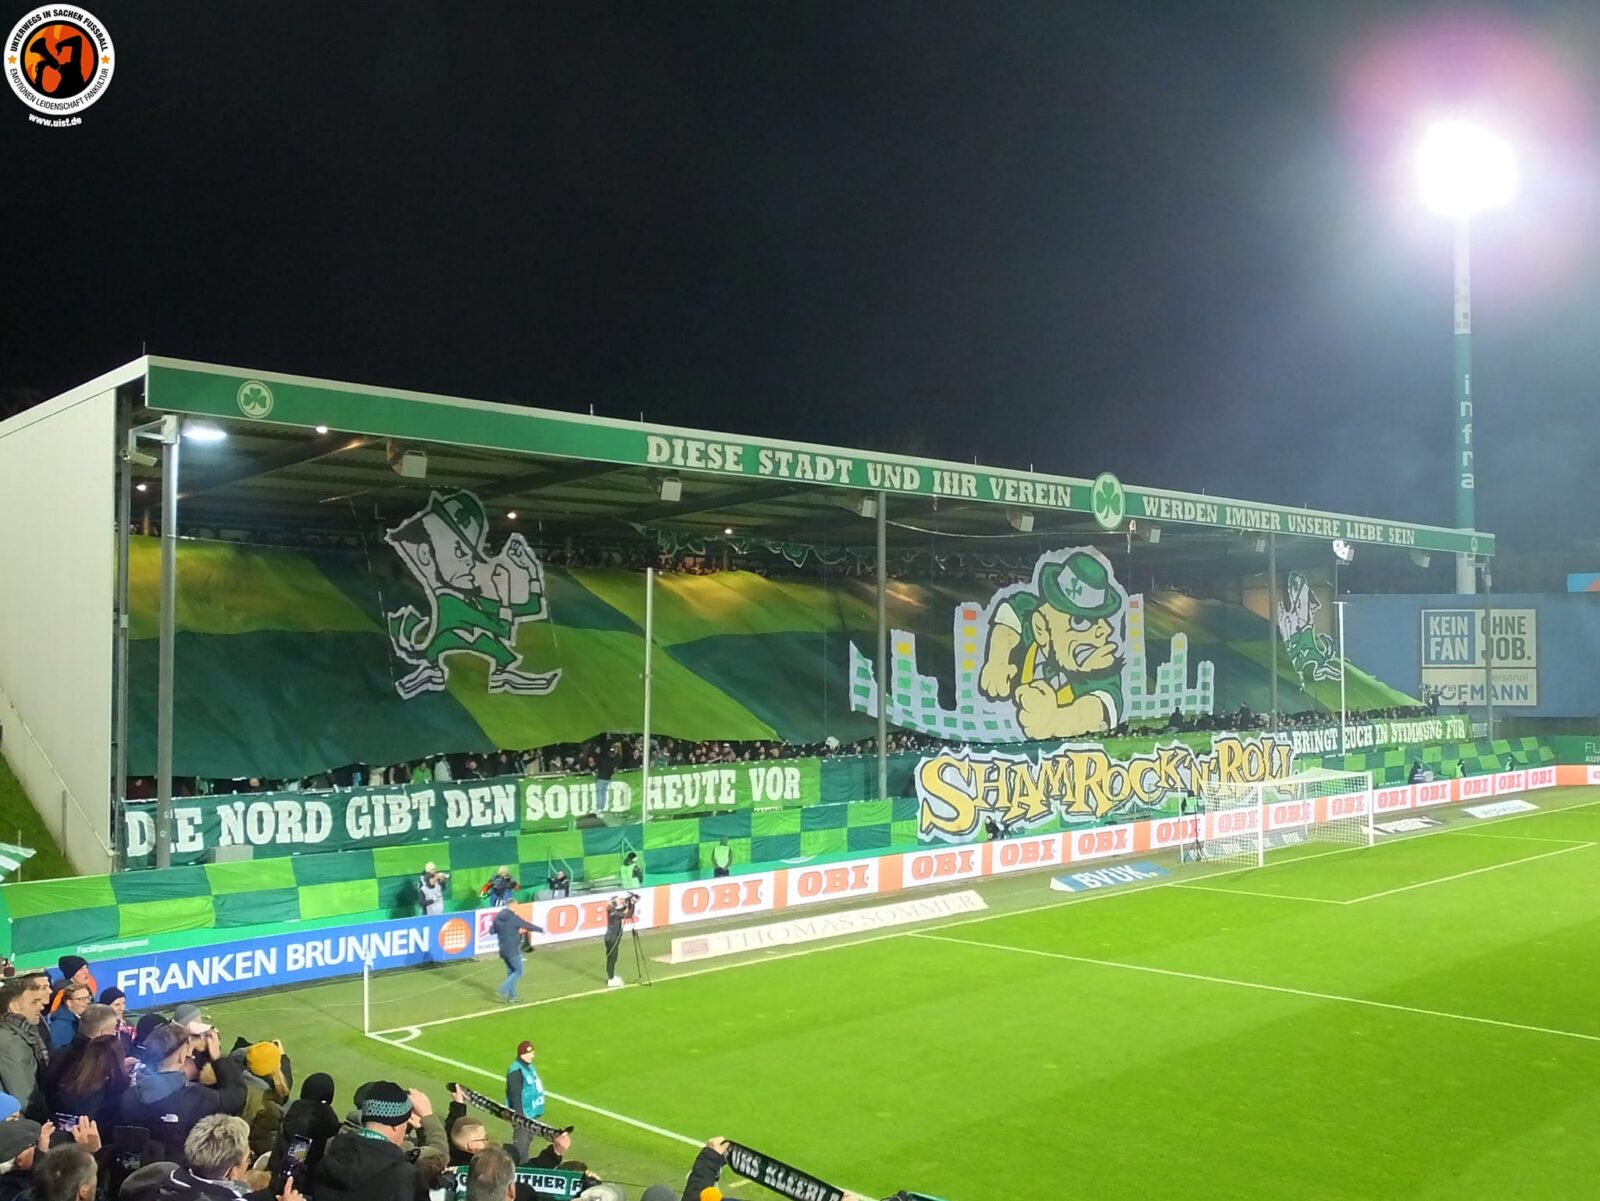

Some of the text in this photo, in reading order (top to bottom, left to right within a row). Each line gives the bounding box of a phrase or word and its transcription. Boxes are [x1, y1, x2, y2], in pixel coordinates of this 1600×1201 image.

[1460, 374, 1475, 489] infra
[645, 435, 1072, 508] DIESE STADT UND IHR VEREIN
[1141, 495, 1416, 546] WERDEN IMMER UNSERE LIEBE SEIN
[1429, 616, 1468, 636] KEIN
[1430, 637, 1468, 660] FAN
[1481, 637, 1531, 660] JOB.
[1489, 673, 1529, 682] ersonal
[1291, 728, 1338, 755] BRINGT
[1344, 724, 1374, 752] EUCH
[1374, 722, 1389, 745] IN
[1463, 778, 1489, 795] OBI
[1499, 774, 1522, 790] OBI
[1531, 769, 1553, 785] OBI
[1377, 789, 1408, 809] OBI
[1420, 784, 1448, 802] OBI
[125, 807, 204, 857] DE
[216, 800, 333, 847] NORD
[345, 790, 435, 840] GIBT
[442, 785, 517, 829] DEN
[647, 769, 737, 810] HEUTE
[749, 767, 801, 801] VOR
[1274, 802, 1311, 825] OBI
[1077, 829, 1127, 856] OBI
[1156, 818, 1200, 843] OBI
[911, 849, 974, 882] OBI
[999, 838, 1056, 867] OBI
[798, 865, 869, 898] OBI
[681, 879, 764, 915] OBI
[718, 918, 854, 951] THOMAS
[859, 894, 976, 925] SOMMER
[116, 926, 431, 998] FRANKEN BRUNNEN
